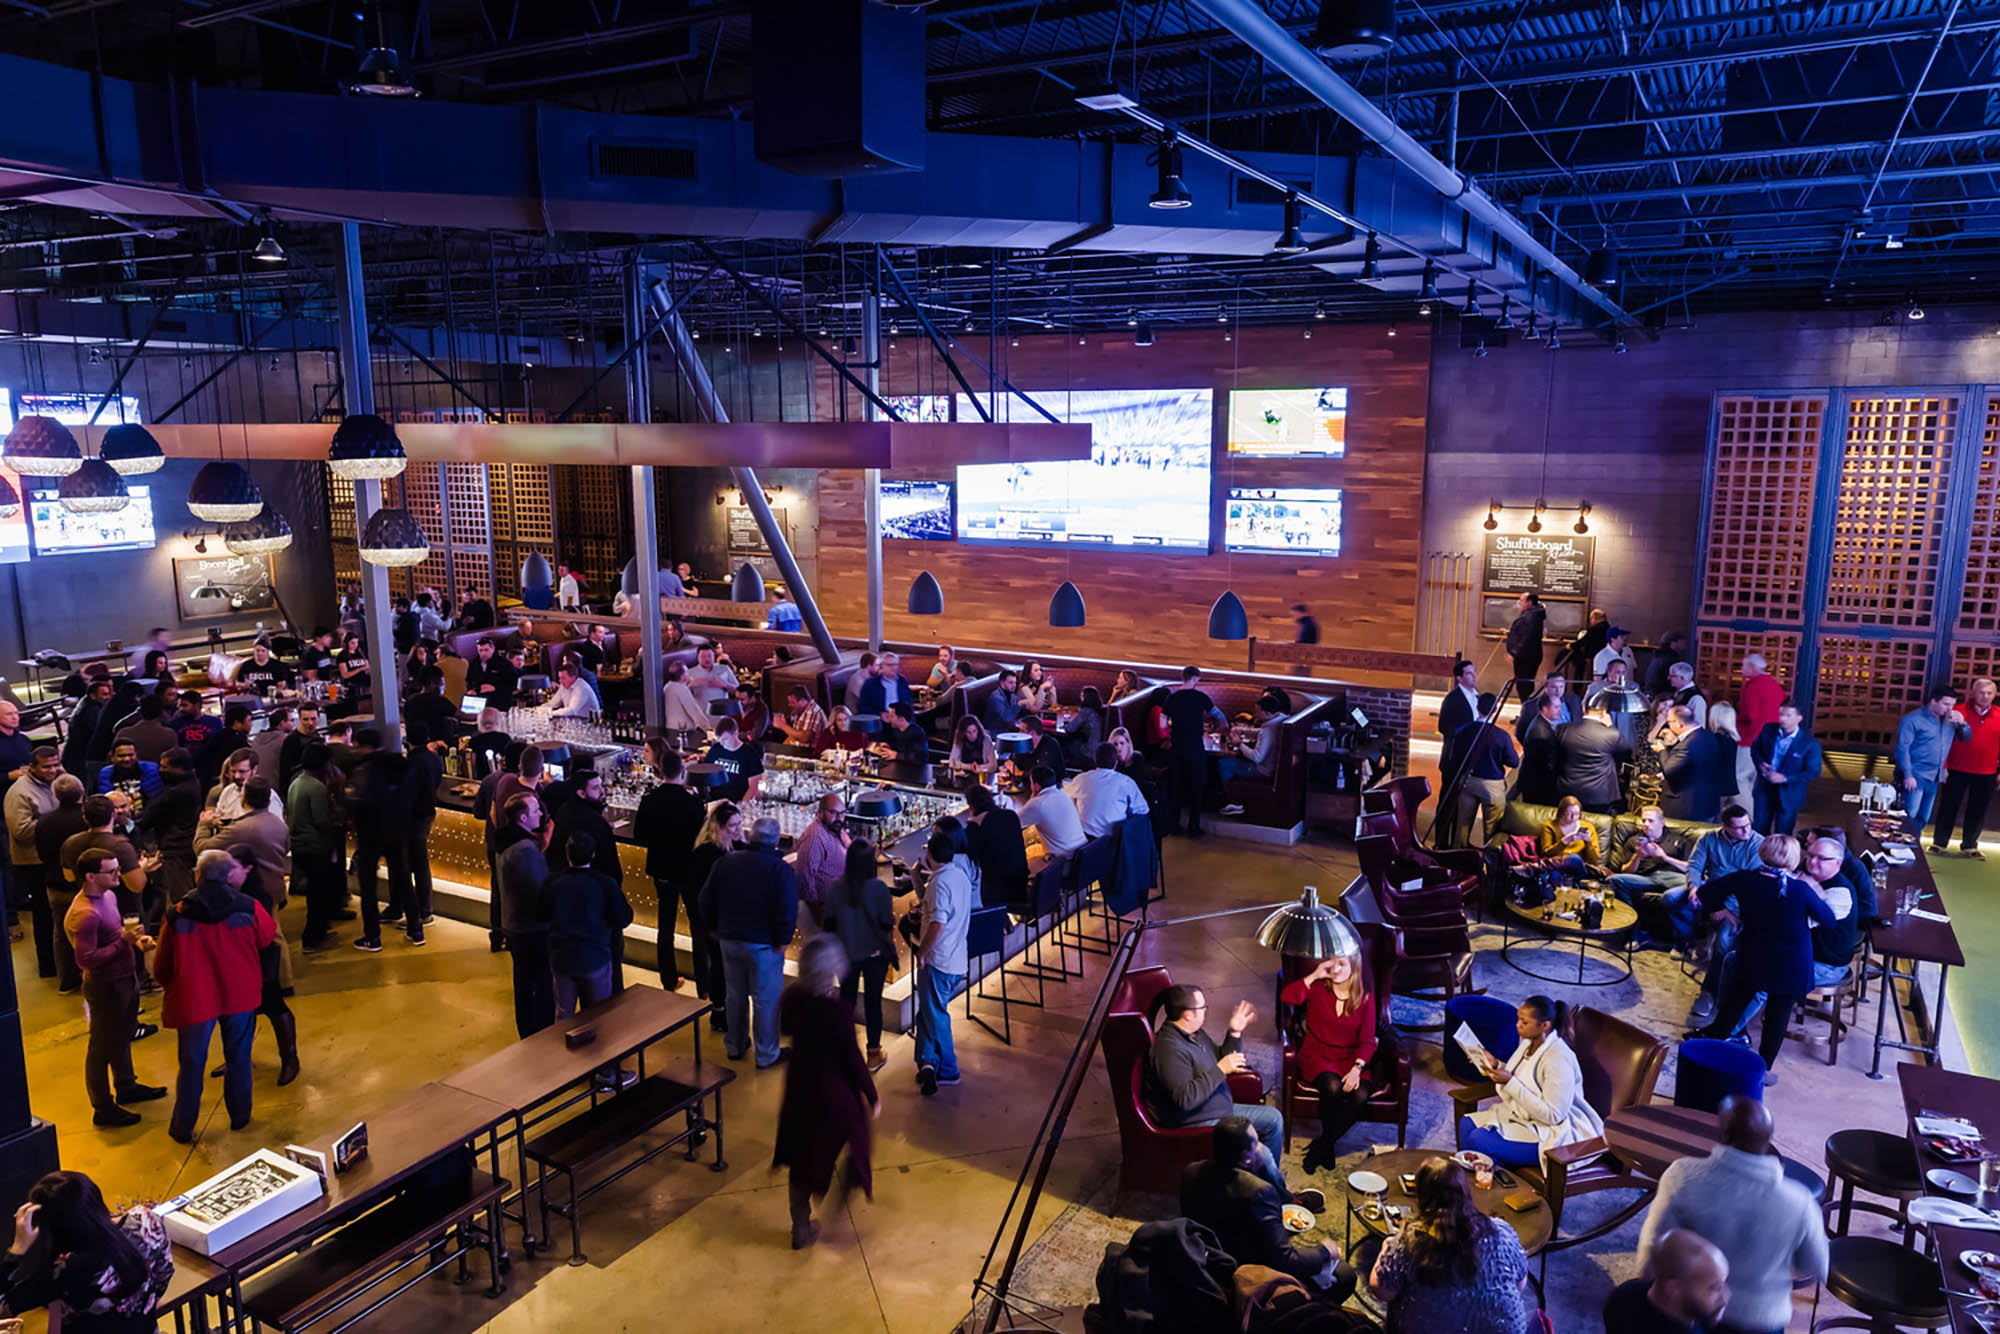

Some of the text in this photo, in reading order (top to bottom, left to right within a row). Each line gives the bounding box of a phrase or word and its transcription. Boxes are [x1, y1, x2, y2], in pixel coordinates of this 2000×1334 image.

[1496, 536, 1573, 551] Shuffleboard
[249, 672, 273, 681] SOCIAL
[185, 729, 205, 742] 85
